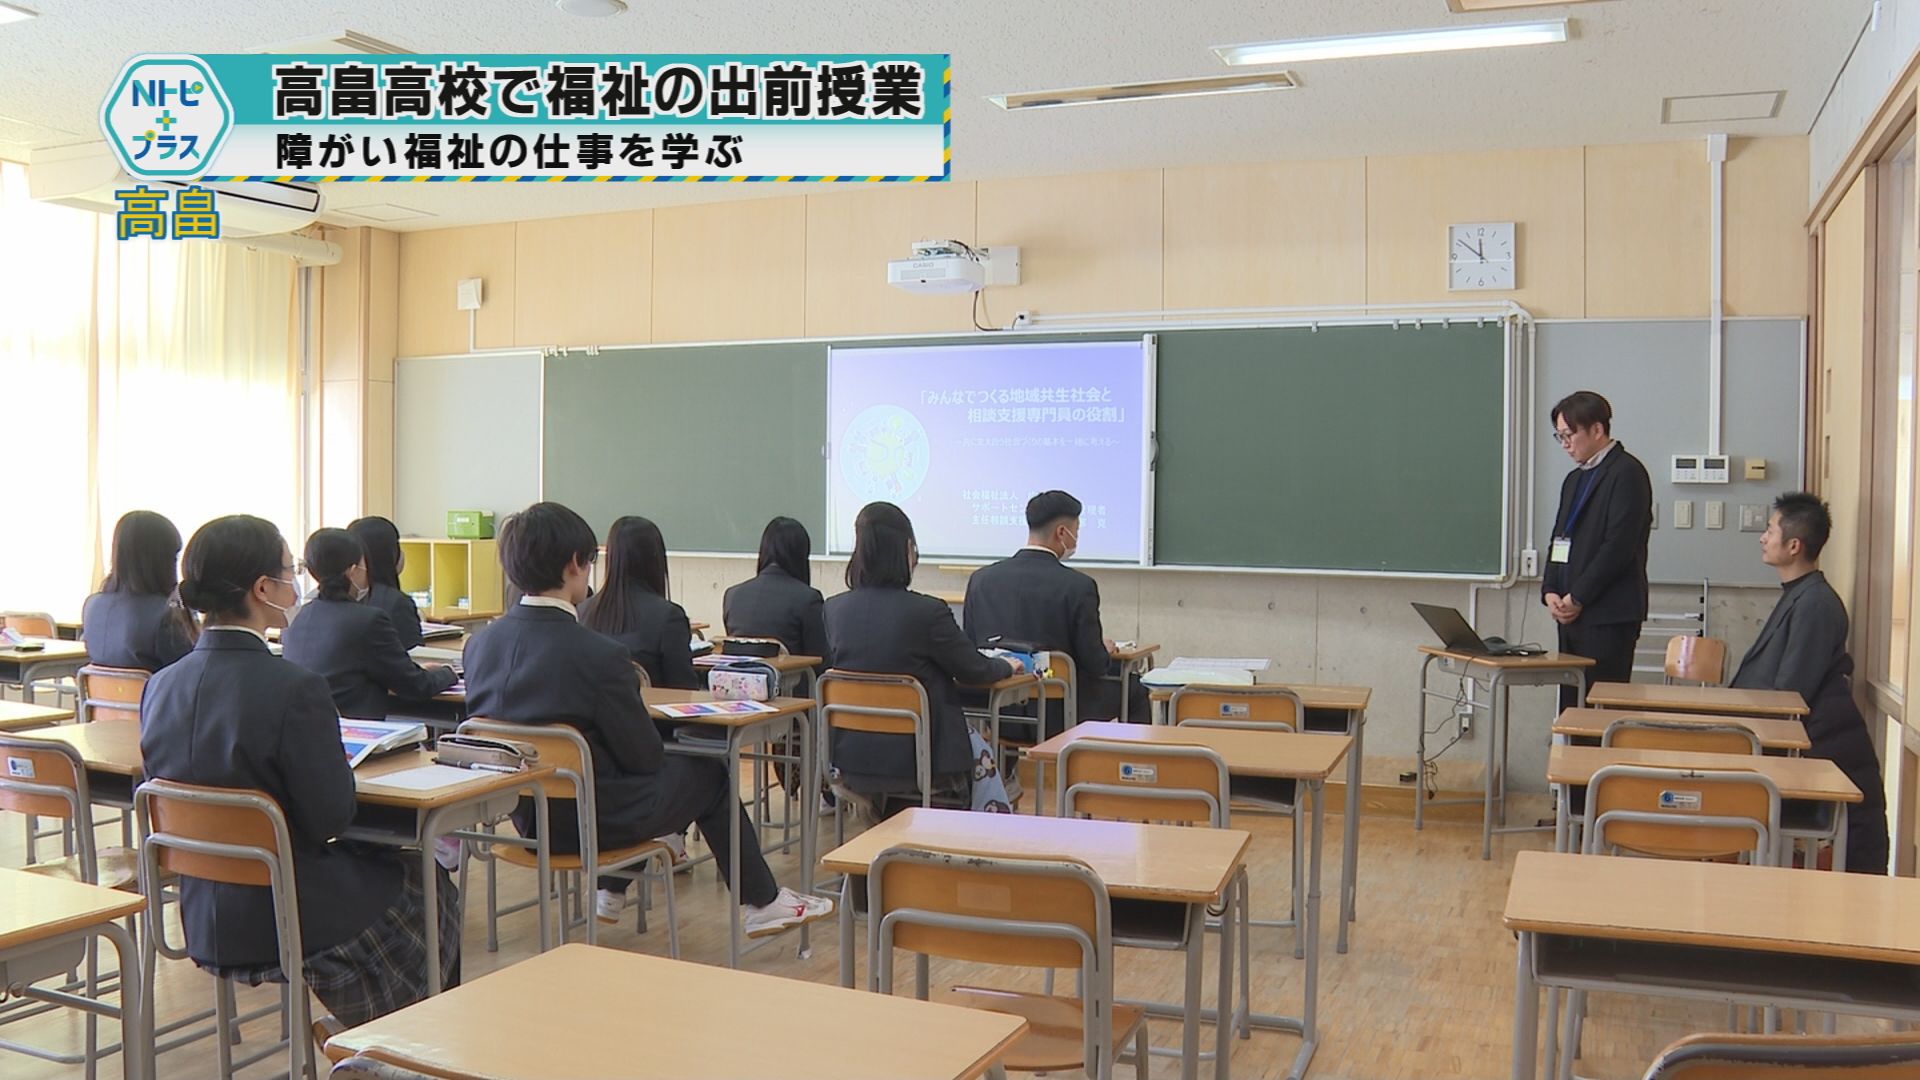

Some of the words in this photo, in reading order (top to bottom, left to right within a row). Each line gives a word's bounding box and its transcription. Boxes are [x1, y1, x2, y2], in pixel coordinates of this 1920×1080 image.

[1477, 227, 1485, 237] 12
[1478, 277, 1485, 287] 6
[920, 387, 1112, 405] 「みんなでつくる地域共生社会と
[967, 407, 1125, 424] 相談支援専門員の役割」
